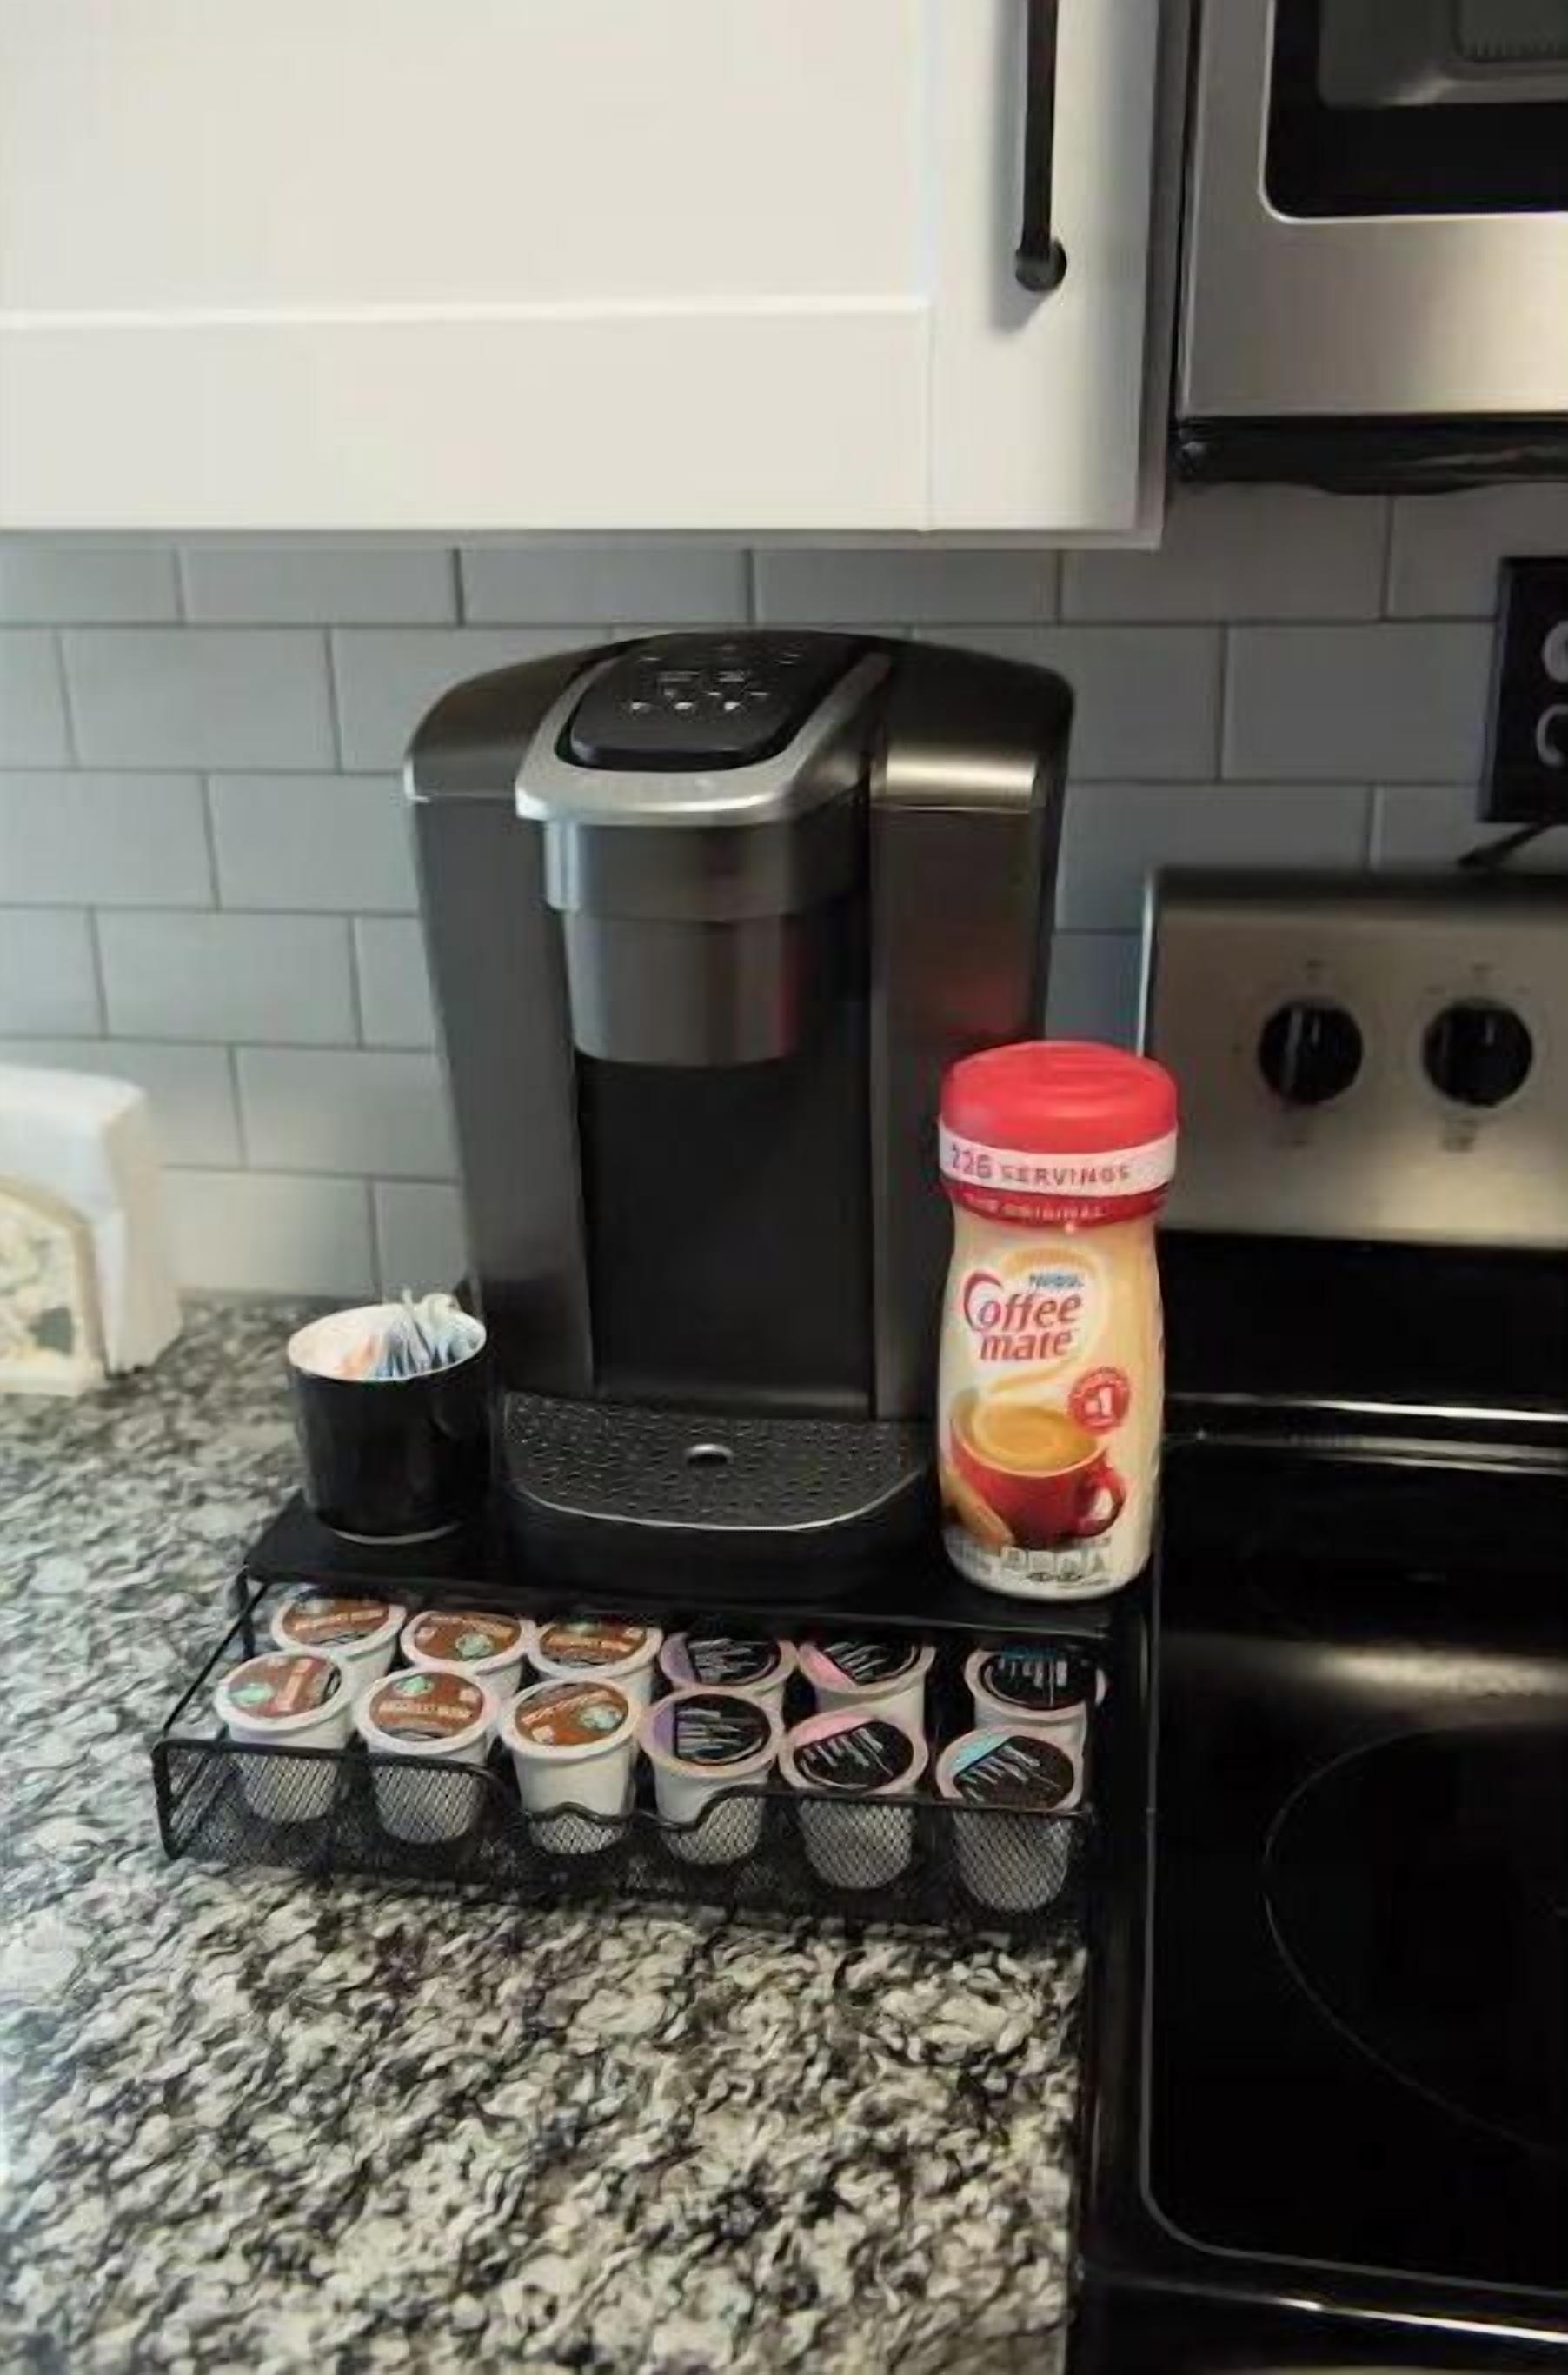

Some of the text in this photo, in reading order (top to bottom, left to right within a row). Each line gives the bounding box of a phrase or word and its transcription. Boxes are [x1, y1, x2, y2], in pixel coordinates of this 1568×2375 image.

[1001, 1165, 1130, 1186] SERVINGS
[963, 1272, 1082, 1333] Coffee
[980, 1331, 1073, 1360] mate
